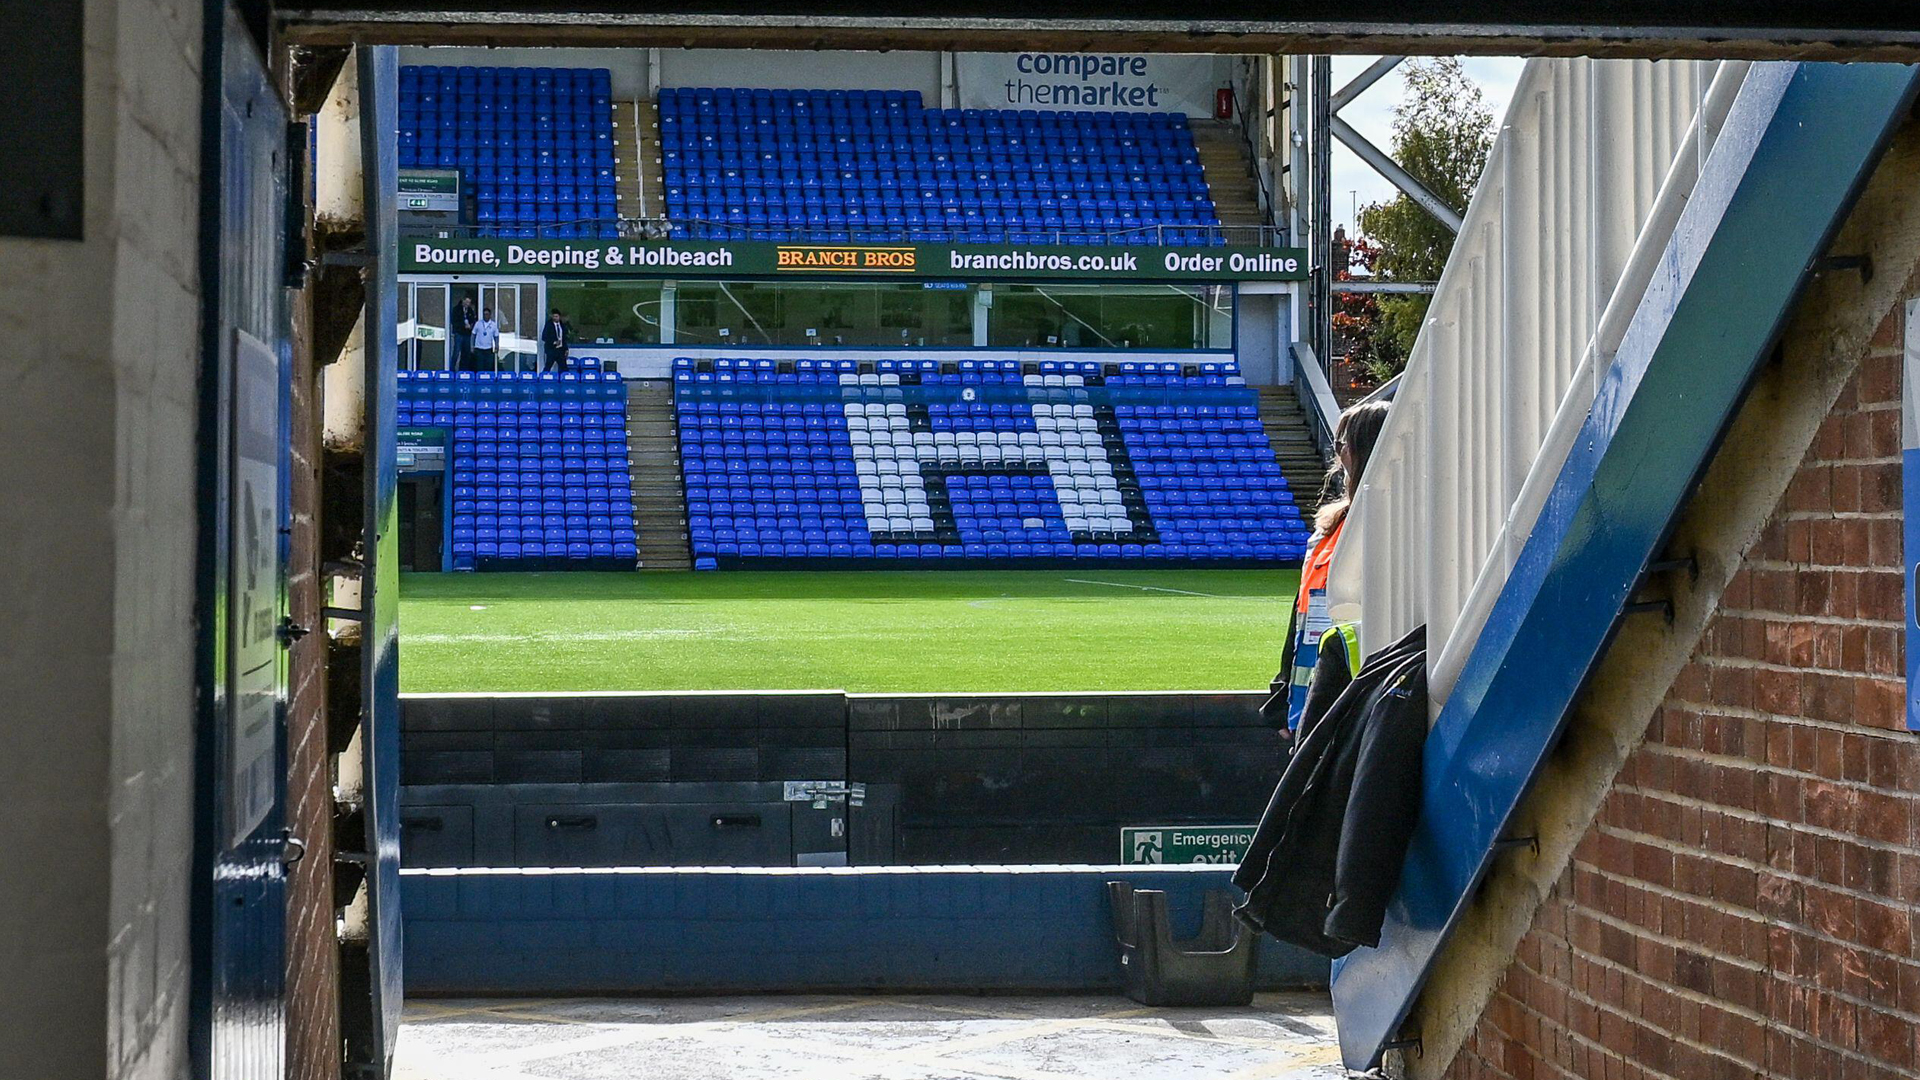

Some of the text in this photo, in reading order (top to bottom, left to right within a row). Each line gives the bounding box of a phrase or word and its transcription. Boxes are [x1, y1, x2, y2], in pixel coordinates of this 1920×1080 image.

[1016, 53, 1147, 81] compare
[1005, 78, 1159, 107] themarket
[415, 244, 733, 269] Bourne, Deeping & Holbeach
[777, 251, 915, 267] BRANCH BROS
[950, 250, 1137, 271] branchbros.co.uk
[1164, 252, 1298, 272] Order Online
